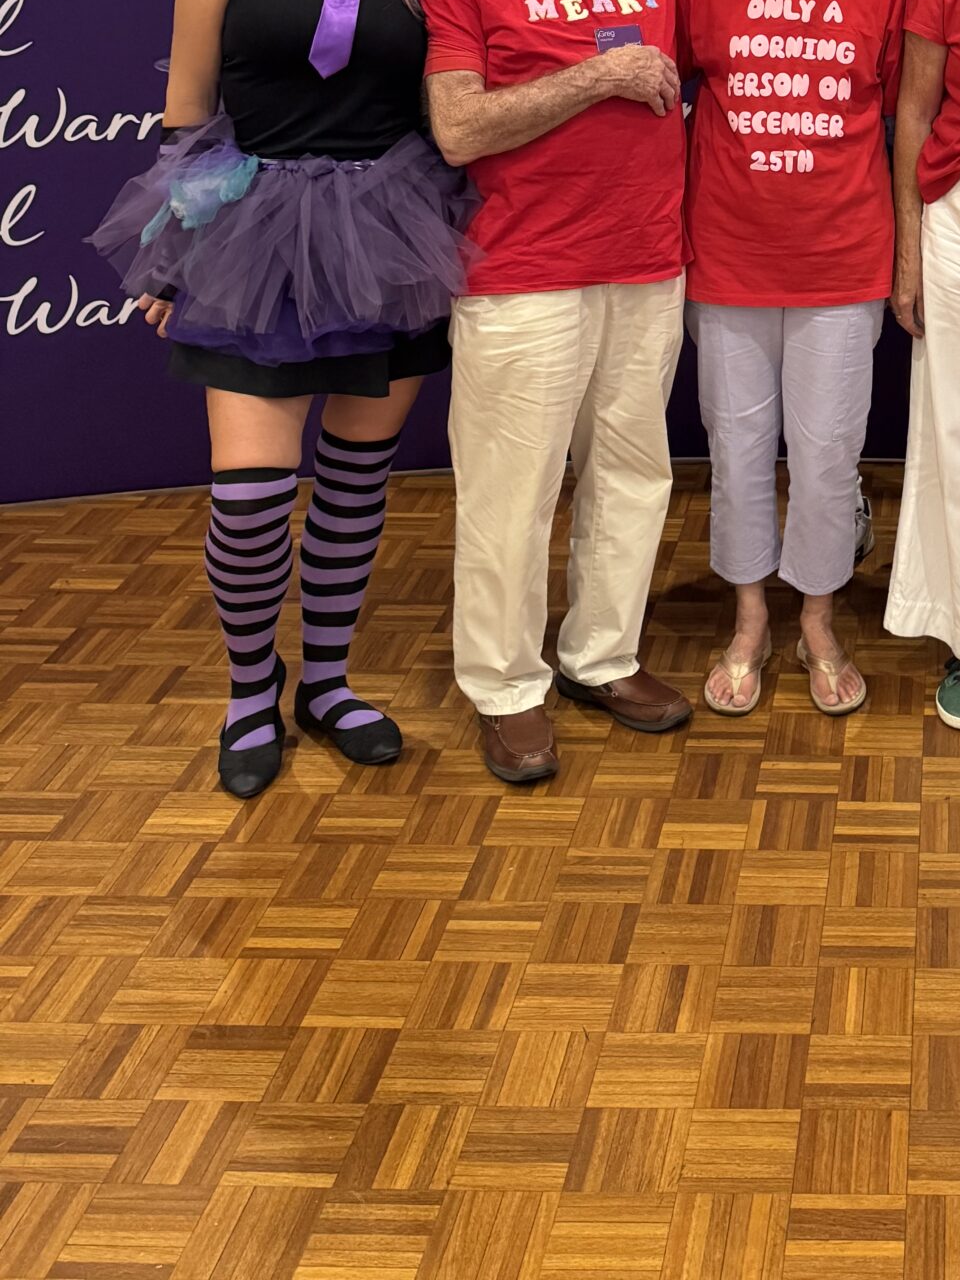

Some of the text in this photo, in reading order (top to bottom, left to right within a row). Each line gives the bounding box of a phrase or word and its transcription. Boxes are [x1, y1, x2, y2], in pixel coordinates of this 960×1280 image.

[823, 0, 844, 23] A
[729, 34, 856, 65] MORNING
[727, 72, 852, 101] PERSON ON
[0, 87, 165, 148] Warr
[727, 110, 845, 138] DECEMBER
[749, 149, 815, 174] 25TH
